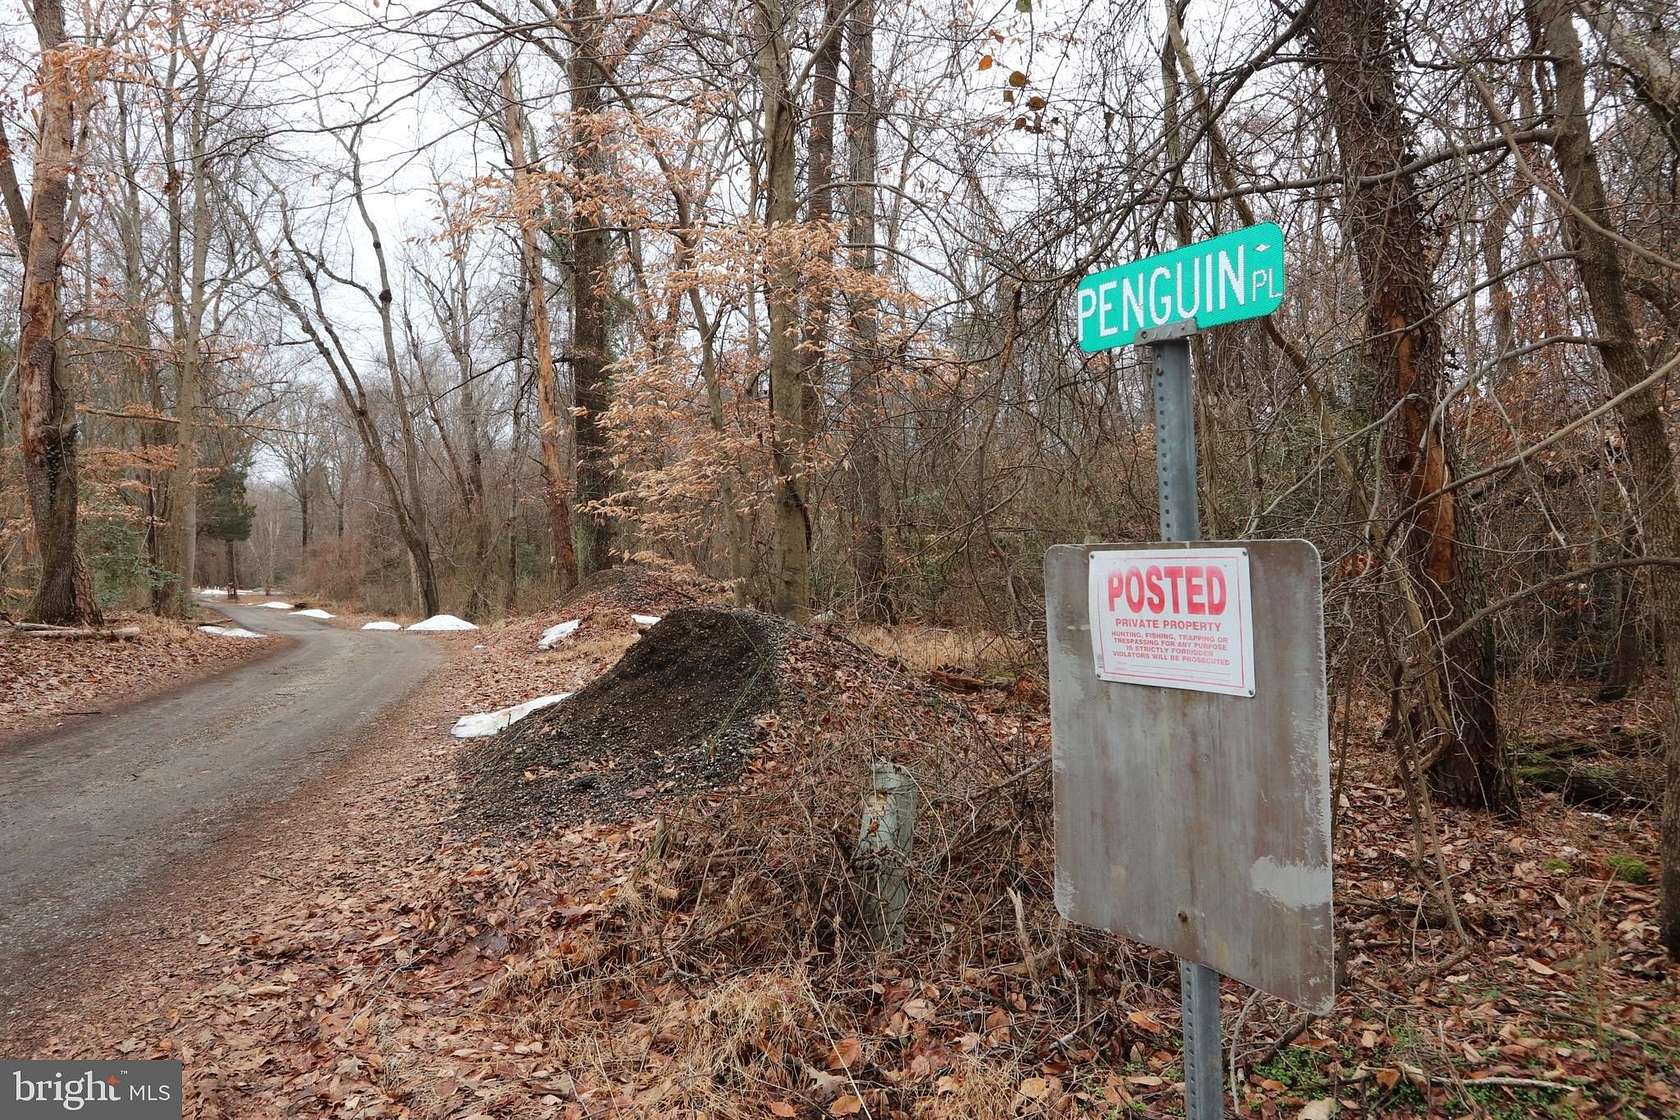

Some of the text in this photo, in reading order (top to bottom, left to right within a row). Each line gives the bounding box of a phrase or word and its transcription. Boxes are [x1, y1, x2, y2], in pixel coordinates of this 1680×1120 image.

[1078, 244, 1283, 342] PENGUIN PL
[1107, 565, 1228, 616] POSTED
[1115, 618, 1222, 632] PRIVATE PROPERTY
[1111, 630, 1143, 639] HUNTING,
[1145, 632, 1176, 640] FISHING,
[1179, 633, 1215, 643] TRAPPING
[1113, 637, 1160, 646] TRESPASSING
[1193, 642, 1228, 651] PURPOSE
[1135, 645, 1169, 654] STRICTLY
[1171, 648, 1214, 656] FORBIDDEN
[1112, 650, 1150, 659] VIOLATORS
[1182, 656, 1231, 666] PROSECUTED
